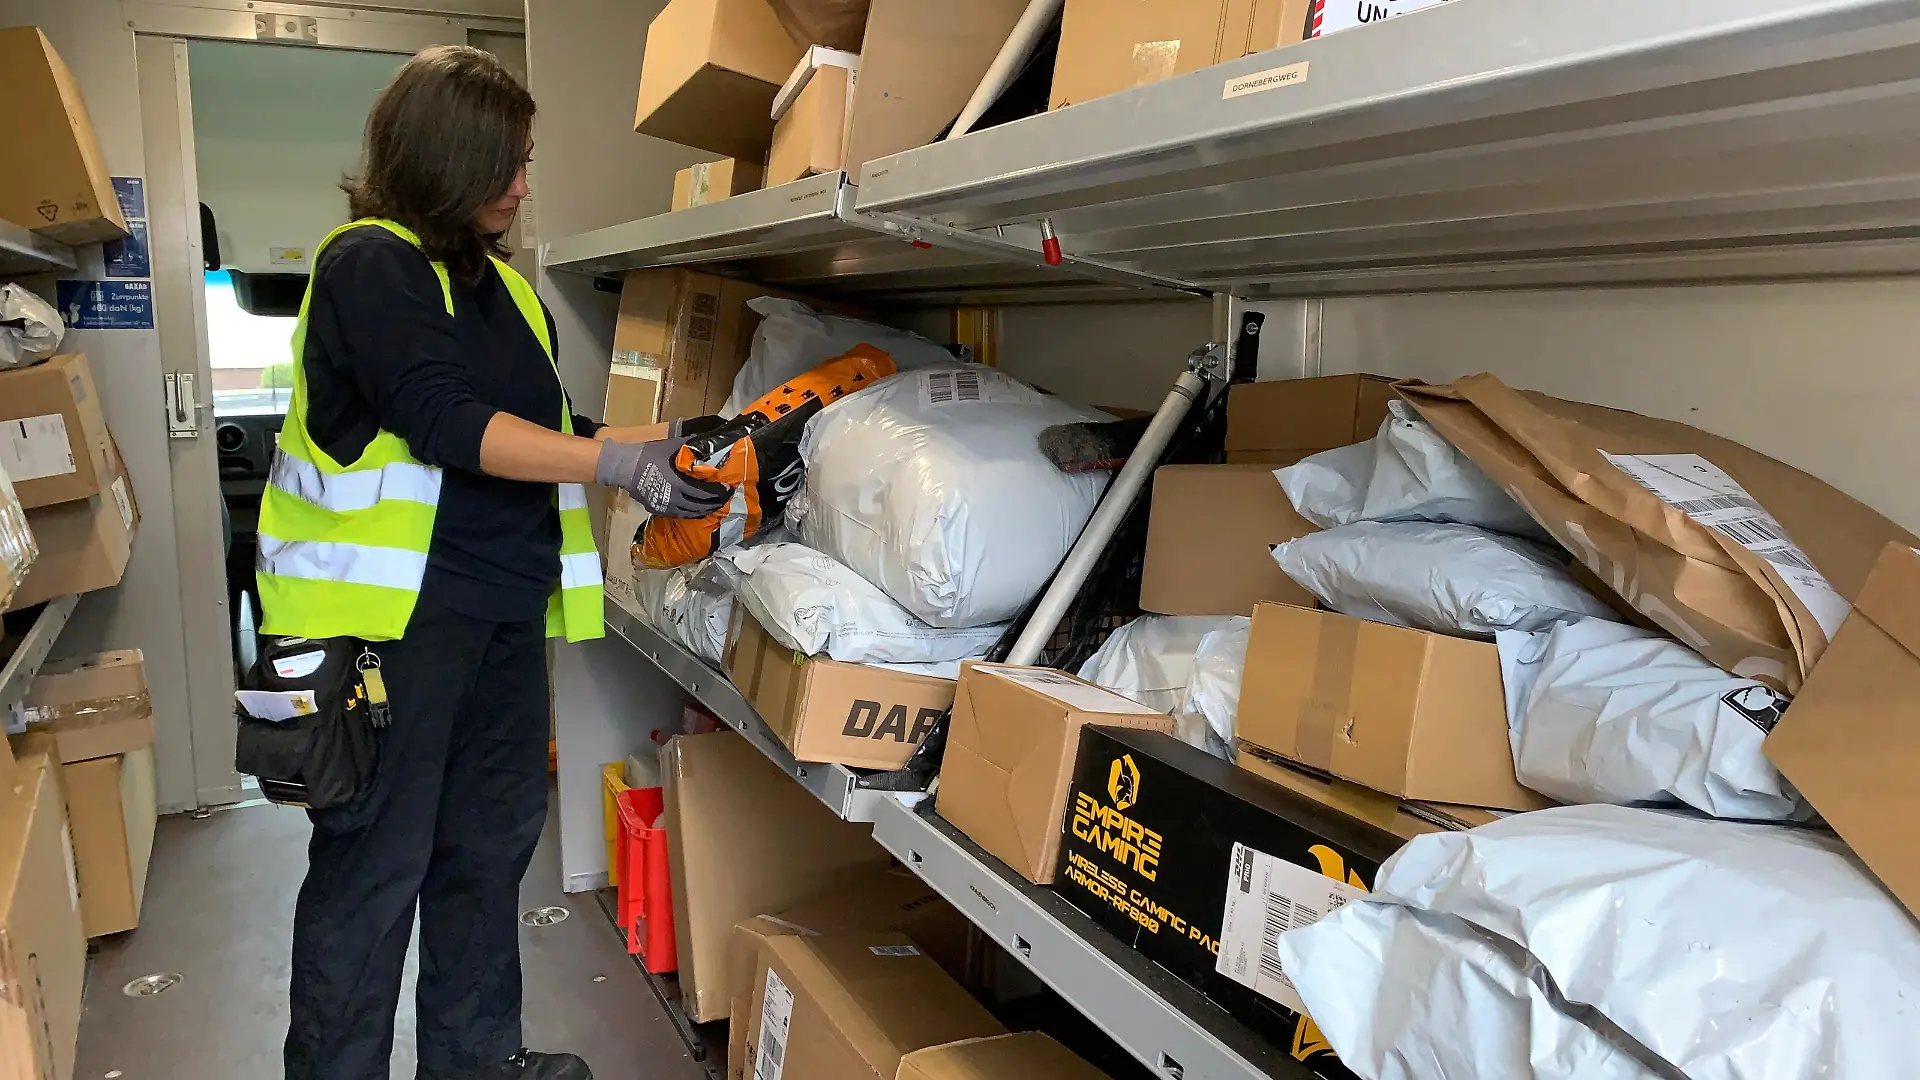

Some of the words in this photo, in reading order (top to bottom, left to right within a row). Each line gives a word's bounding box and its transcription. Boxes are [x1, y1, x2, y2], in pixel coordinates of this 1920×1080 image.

[1232, 71, 1298, 92] DORNEBERGWEG
[111, 292, 149, 300] Zurrpunkte
[1072, 814, 1159, 882] GAMING
[1076, 791, 1163, 858] EMPIRE
[1234, 846, 1244, 878] DHL
[1243, 863, 1251, 883] PRIO
[1064, 865, 1160, 934] ARMOR-RF800
[1069, 849, 1128, 896] WIRELESS
[1130, 889, 1187, 934] GAMING
